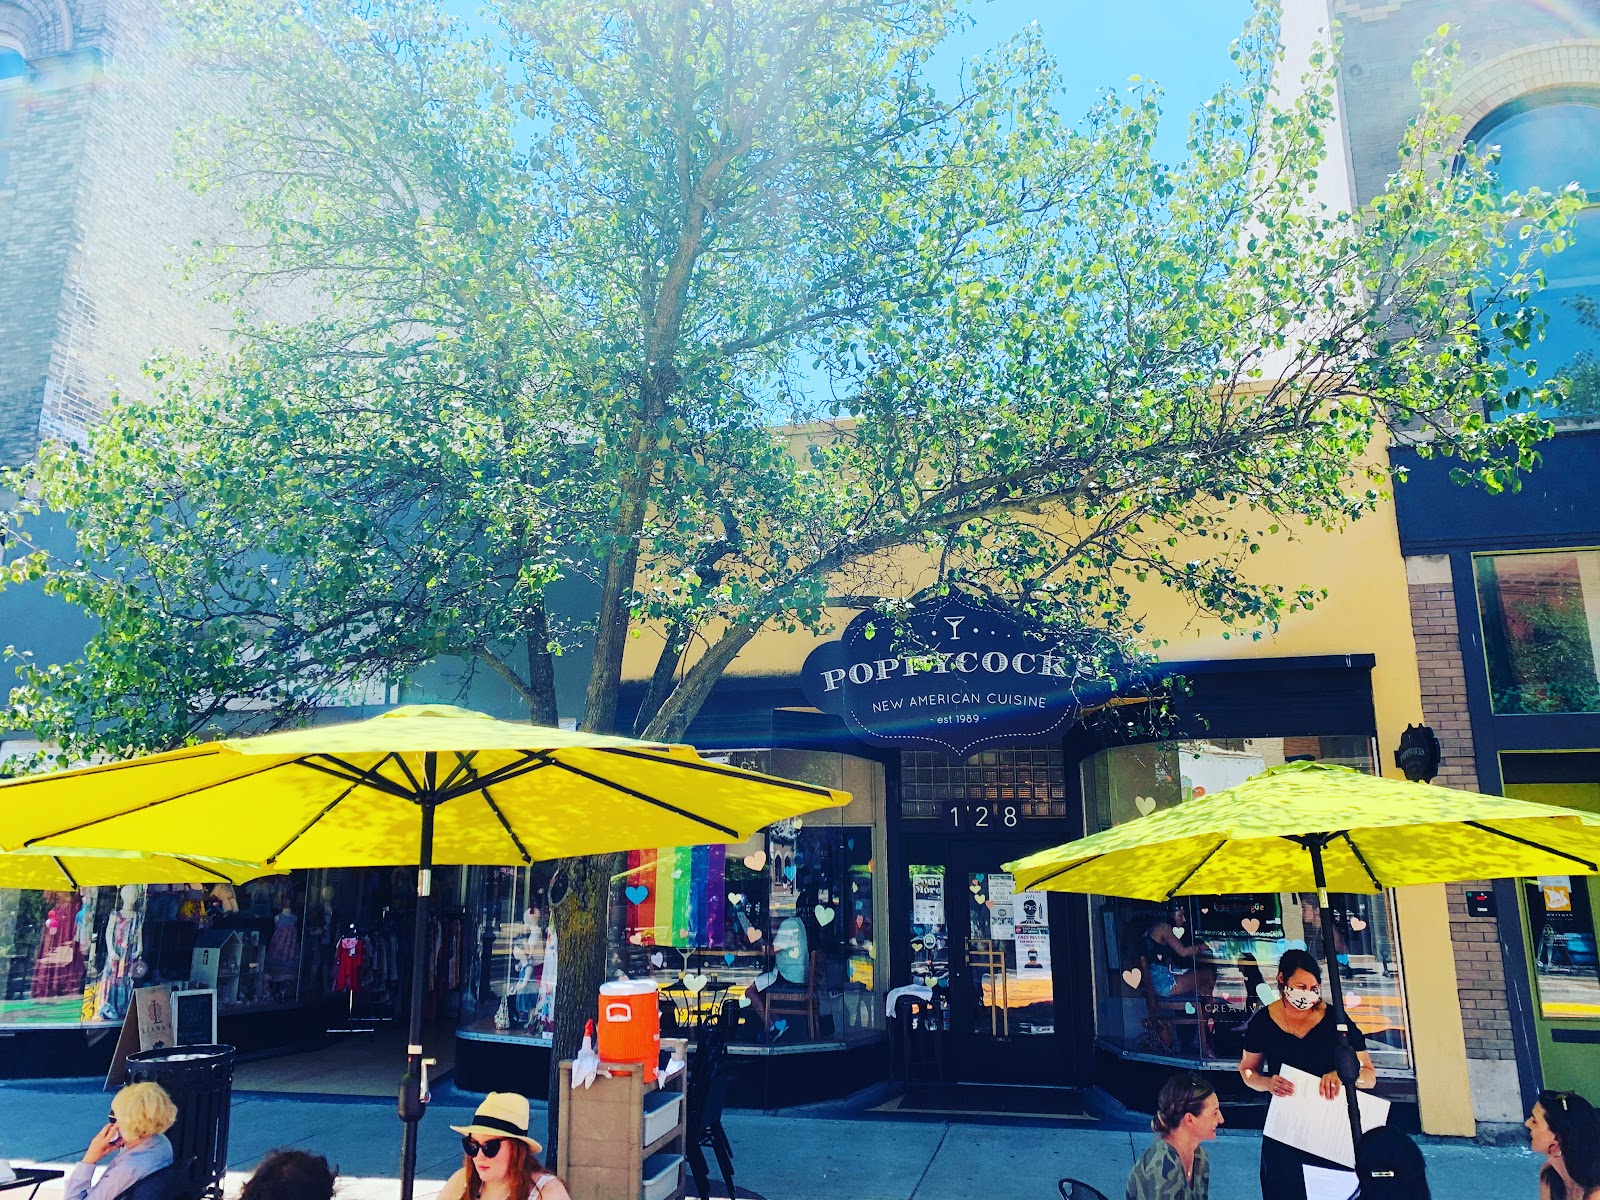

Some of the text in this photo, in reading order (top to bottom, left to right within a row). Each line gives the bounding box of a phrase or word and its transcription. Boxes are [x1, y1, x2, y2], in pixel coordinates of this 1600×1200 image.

[872, 692, 1047, 713] NEW AMERICAN CUISINE
[936, 713, 980, 725] est 1989
